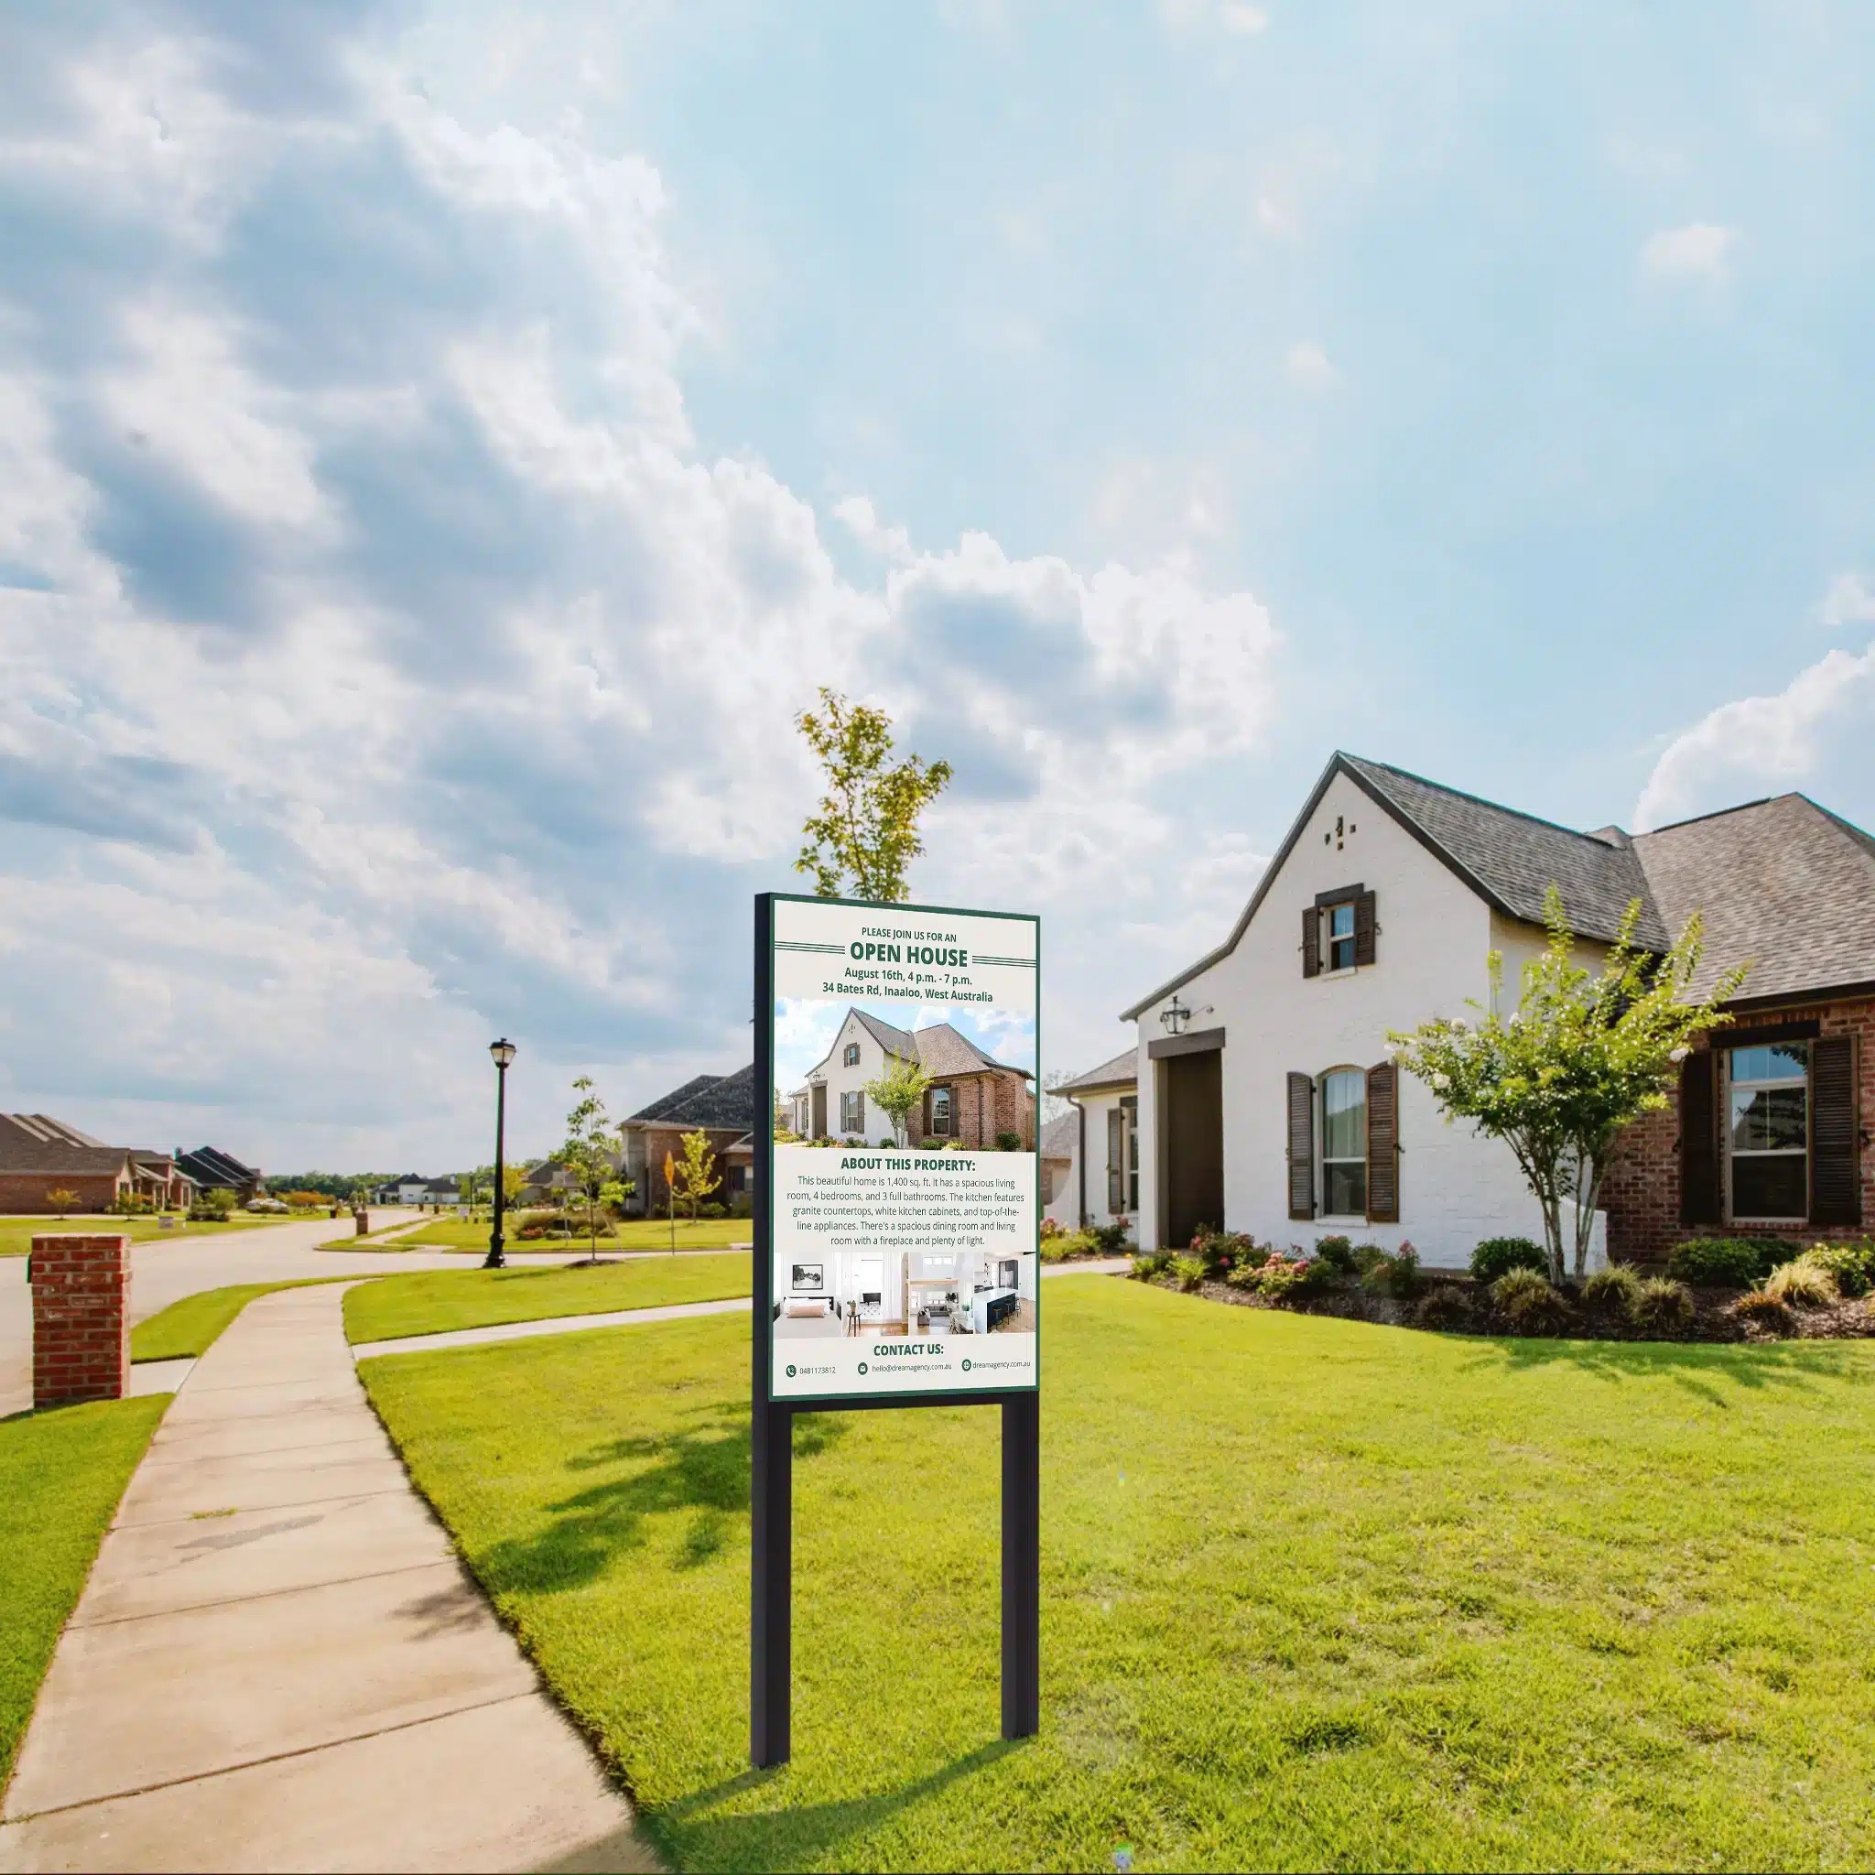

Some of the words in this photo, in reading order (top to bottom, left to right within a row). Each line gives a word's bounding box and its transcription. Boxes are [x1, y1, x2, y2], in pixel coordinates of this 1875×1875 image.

[861, 927, 891, 938] PLEASE
[892, 929, 911, 940] JOIN
[914, 931, 925, 940] US
[927, 932, 943, 941] FOR
[944, 933, 957, 942] AN
[850, 941, 901, 962] OPEN
[907, 946, 968, 967] HOUSE
[845, 967, 879, 981] August
[882, 969, 905, 982] 16th,
[908, 972, 914, 981] 4
[915, 974, 936, 985] p.m.
[944, 973, 950, 983] 7
[952, 976, 973, 987] p.m.
[822, 982, 834, 993] 34
[837, 983, 864, 995] Bates
[866, 984, 882, 997] Rd,
[884, 986, 923, 999] Inaaloo,
[925, 988, 948, 999] West
[951, 990, 993, 1002] Australia
[841, 1157, 882, 1169] ABOUT
[885, 1159, 911, 1170] THIS
[914, 1159, 975, 1171] PROPERTY:
[798, 1176, 814, 1185] This
[816, 1176, 852, 1186] beautiful
[854, 1177, 877, 1186] home
[879, 1178, 885, 1186] is
[888, 1177, 907, 1187] 1,400
[940, 1178, 953, 1187] has
[962, 1179, 994, 1190] spacious
[996, 1179, 1015, 1189] living
[787, 1193, 811, 1201] room,
[813, 1192, 818, 1200] 4
[866, 1192, 880, 1200] and
[883, 1192, 887, 1200] 3
[889, 1192, 901, 1201] full
[949, 1193, 963, 1201] The
[966, 1193, 992, 1201] kitchen
[994, 1193, 1024, 1202] features
[793, 1206, 821, 1217] granite
[823, 1207, 873, 1217] countertops,
[875, 1207, 897, 1215] white
[899, 1207, 926, 1216] kitchen
[964, 1208, 978, 1216] and
[797, 1221, 812, 1230] line
[898, 1222, 930, 1232] spacious
[933, 1222, 956, 1232] dining
[980, 1222, 994, 1230] and
[996, 1222, 1015, 1232] living
[854, 1236, 871, 1245] with
[880, 1236, 913, 1247] fireplace
[915, 1236, 930, 1245] and
[931, 1236, 955, 1247] plenty
[957, 1236, 965, 1245] of
[966, 1236, 985, 1247] light.
[873, 1345, 924, 1356] CONTACT
[927, 1344, 944, 1354] US:
